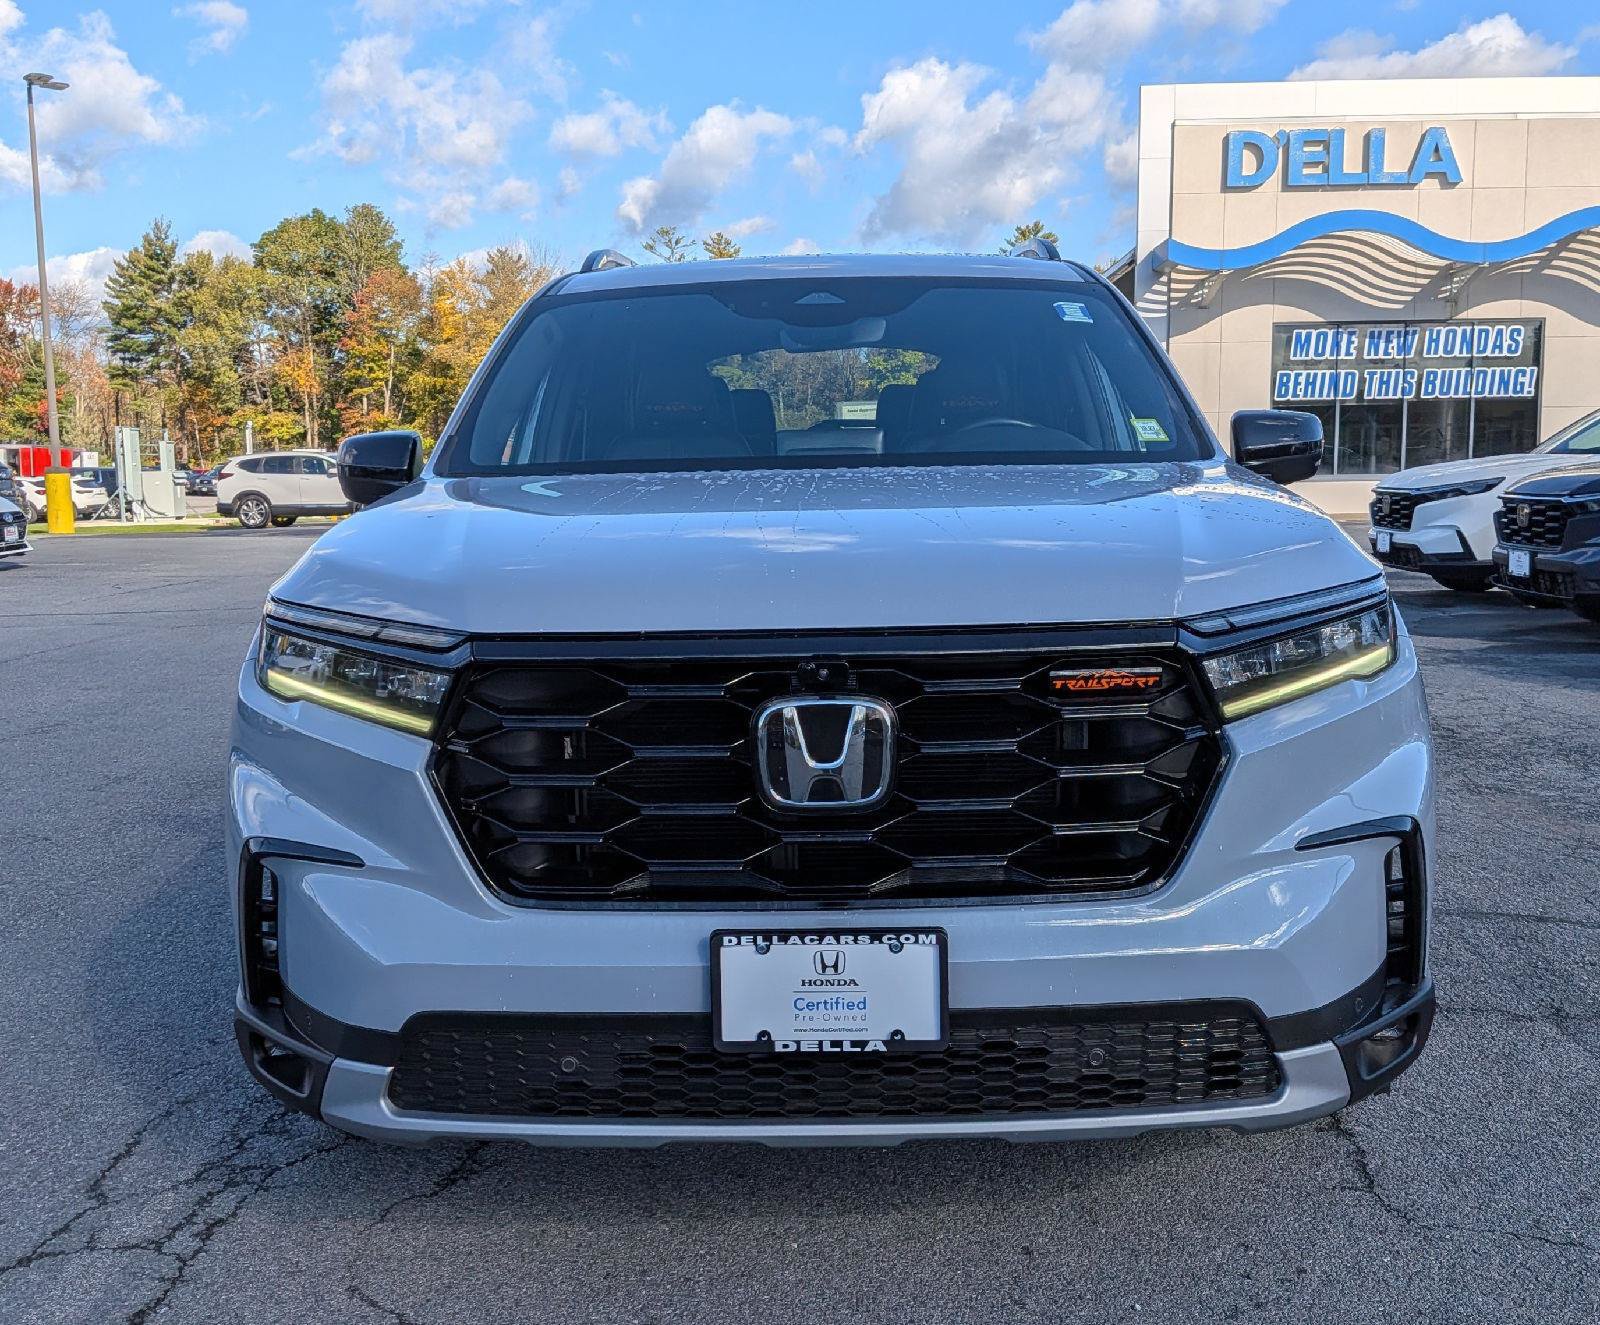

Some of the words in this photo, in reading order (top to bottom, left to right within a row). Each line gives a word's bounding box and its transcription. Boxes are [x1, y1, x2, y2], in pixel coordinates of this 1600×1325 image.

[1227, 127, 1463, 187] D'ELLA
[1290, 328, 1358, 360] MORE
[1364, 327, 1418, 359] NEW
[1424, 325, 1524, 358] HONDAS
[1275, 370, 1358, 400] BEHIND
[1364, 368, 1417, 399] THIS
[1421, 366, 1537, 399] BUILDING!
[1052, 676, 1160, 690] TRAILSPORT
[722, 934, 937, 946] DELLACARS.COM
[801, 978, 859, 987] HONDA
[793, 997, 867, 1011] Certified
[794, 1013, 867, 1021] Pre-Owned
[774, 1040, 888, 1052] DELLA
